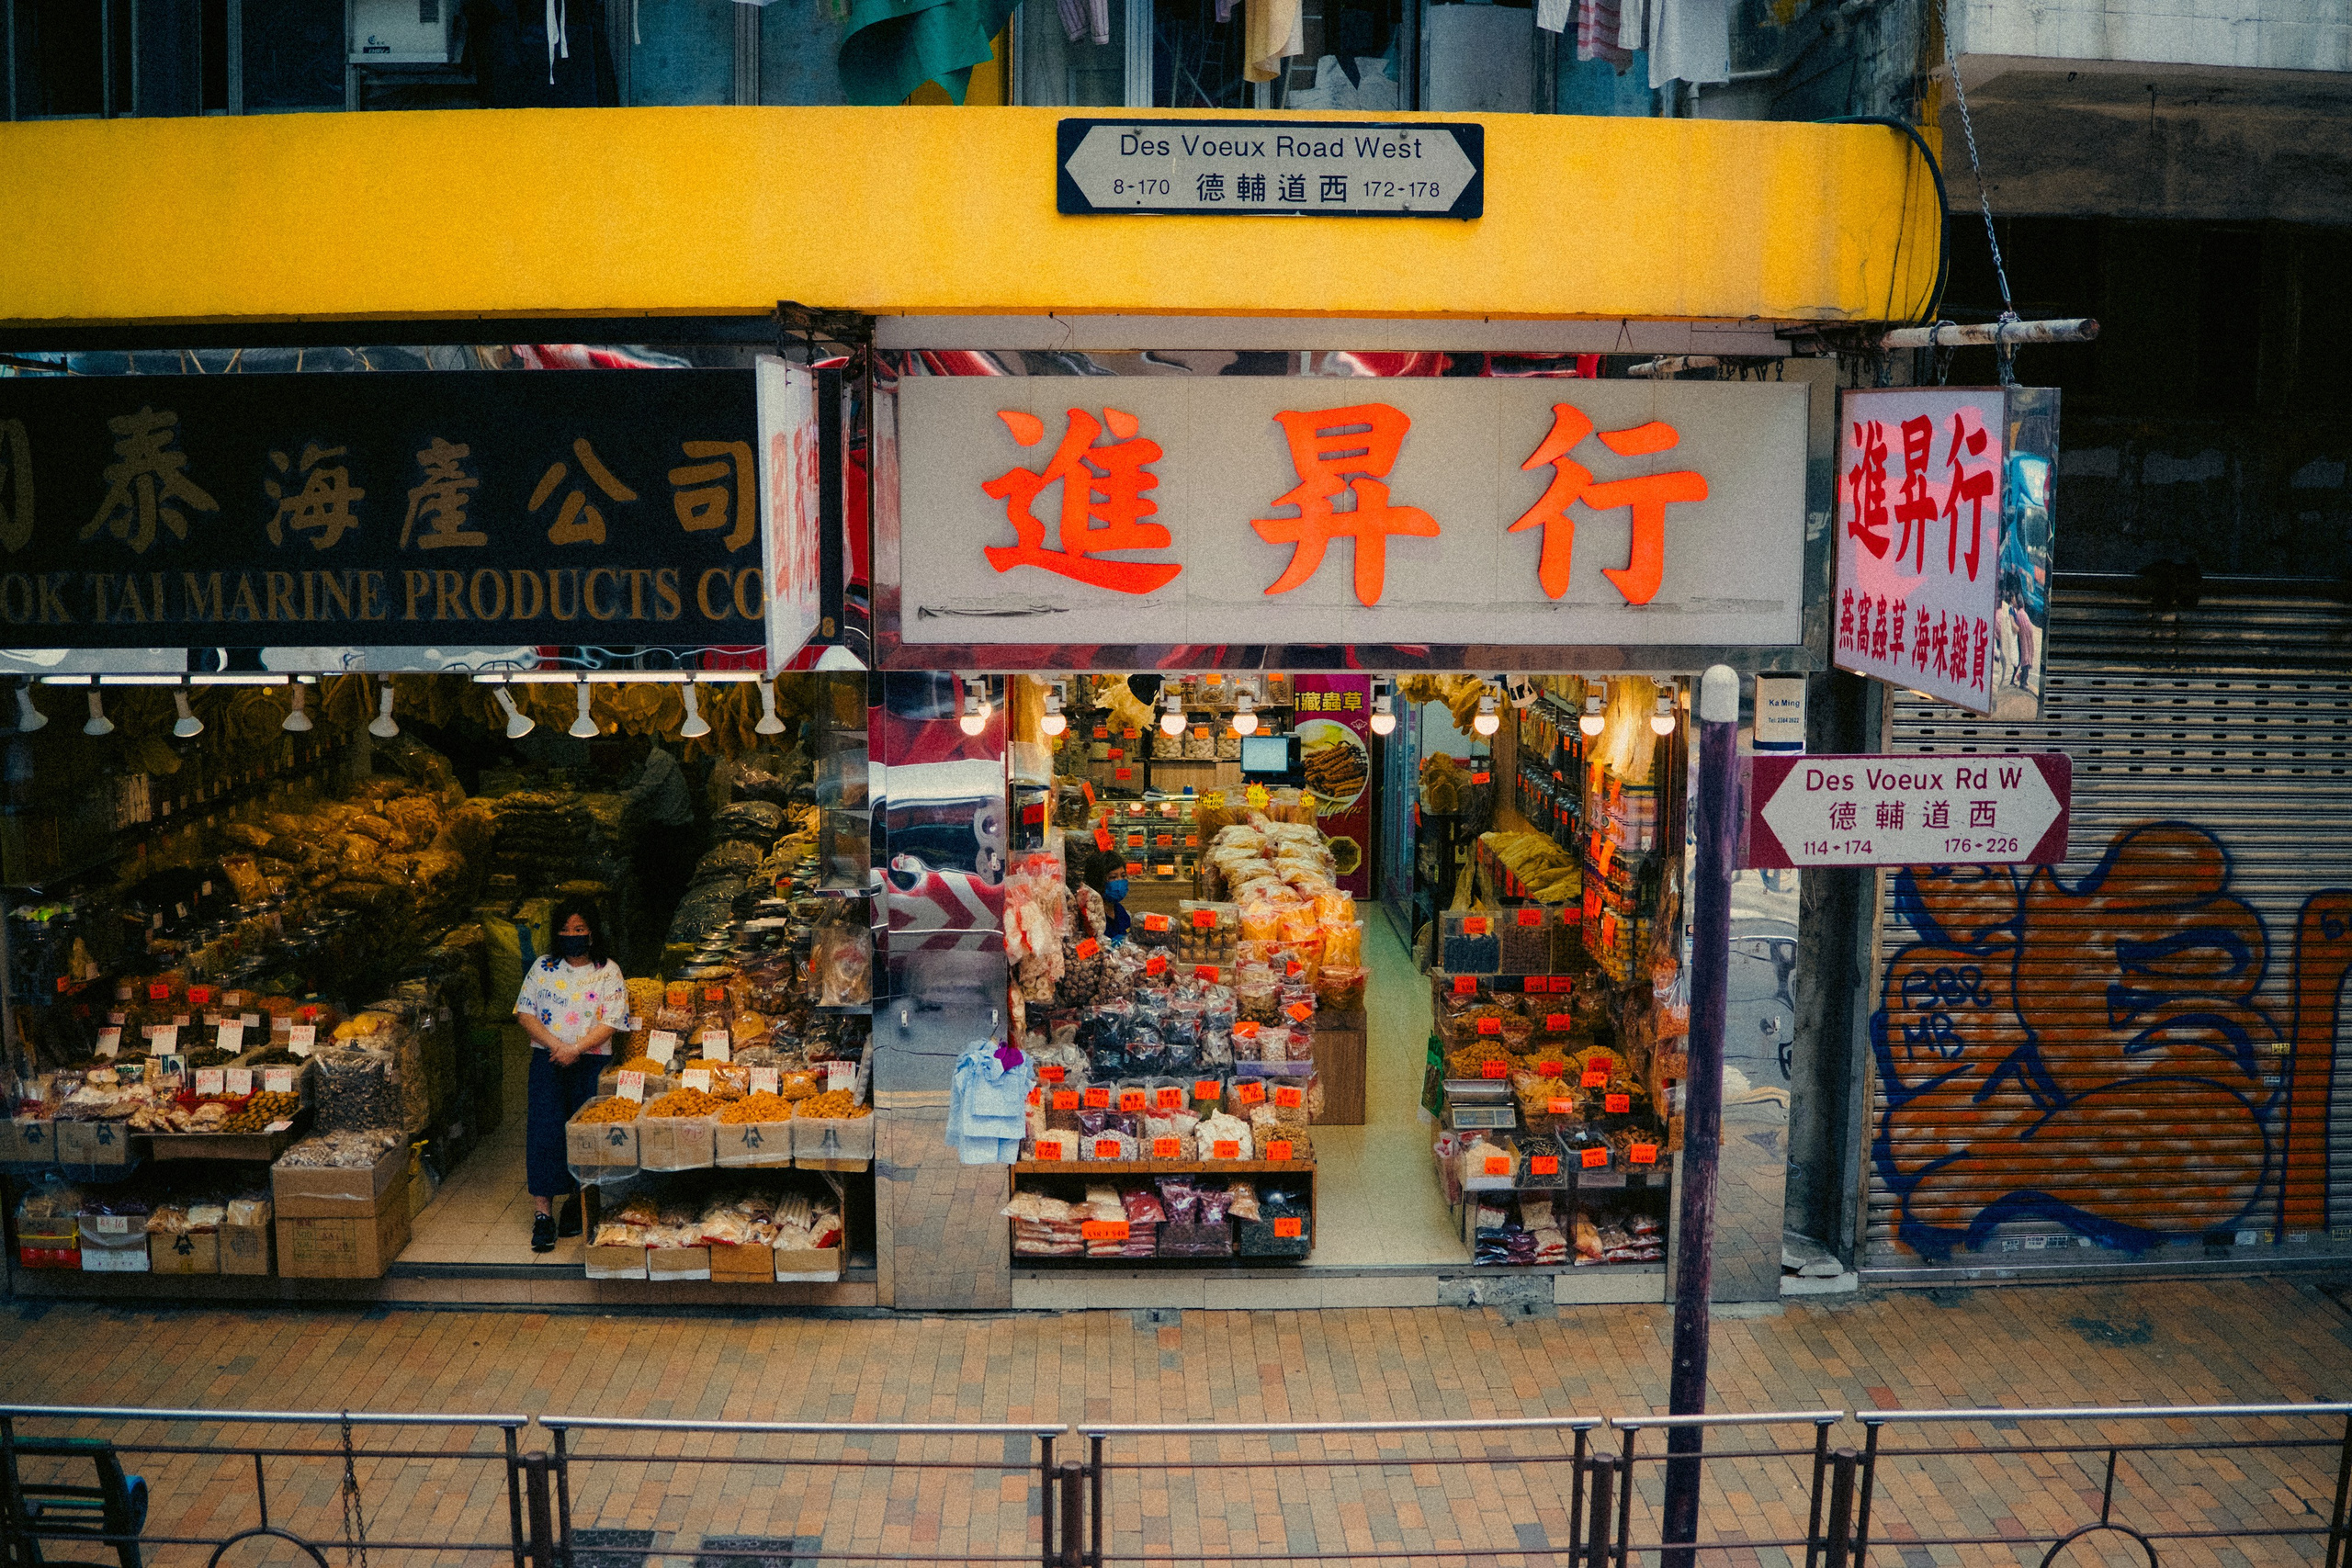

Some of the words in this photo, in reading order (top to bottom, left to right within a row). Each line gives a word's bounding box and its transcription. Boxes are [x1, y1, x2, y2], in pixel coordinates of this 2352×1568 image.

[1120, 134, 1170, 157] Des
[1181, 134, 1265, 158] Voeux
[1276, 135, 1344, 158] Road
[1354, 136, 1422, 160] West
[1195, 172, 1349, 203] 德輔道西
[0, 405, 757, 553] 泰海產公司
[1847, 412, 1994, 582] 進昇行
[980, 400, 1709, 607] 進昇行
[85, 571, 167, 623] TAI
[185, 570, 389, 622] MARINE
[403, 567, 682, 622] PRODUCTS
[1838, 587, 1907, 666] 燕窩蟲草
[1911, 604, 1989, 694] 海味雜貨
[1781, 699, 1801, 708] Ming
[1805, 769, 1854, 792] Des
[1866, 768, 1944, 791] Voeux
[1955, 767, 1987, 790] Rd
[1998, 766, 2022, 790] W
[1828, 800, 1998, 830] 德輔道西
